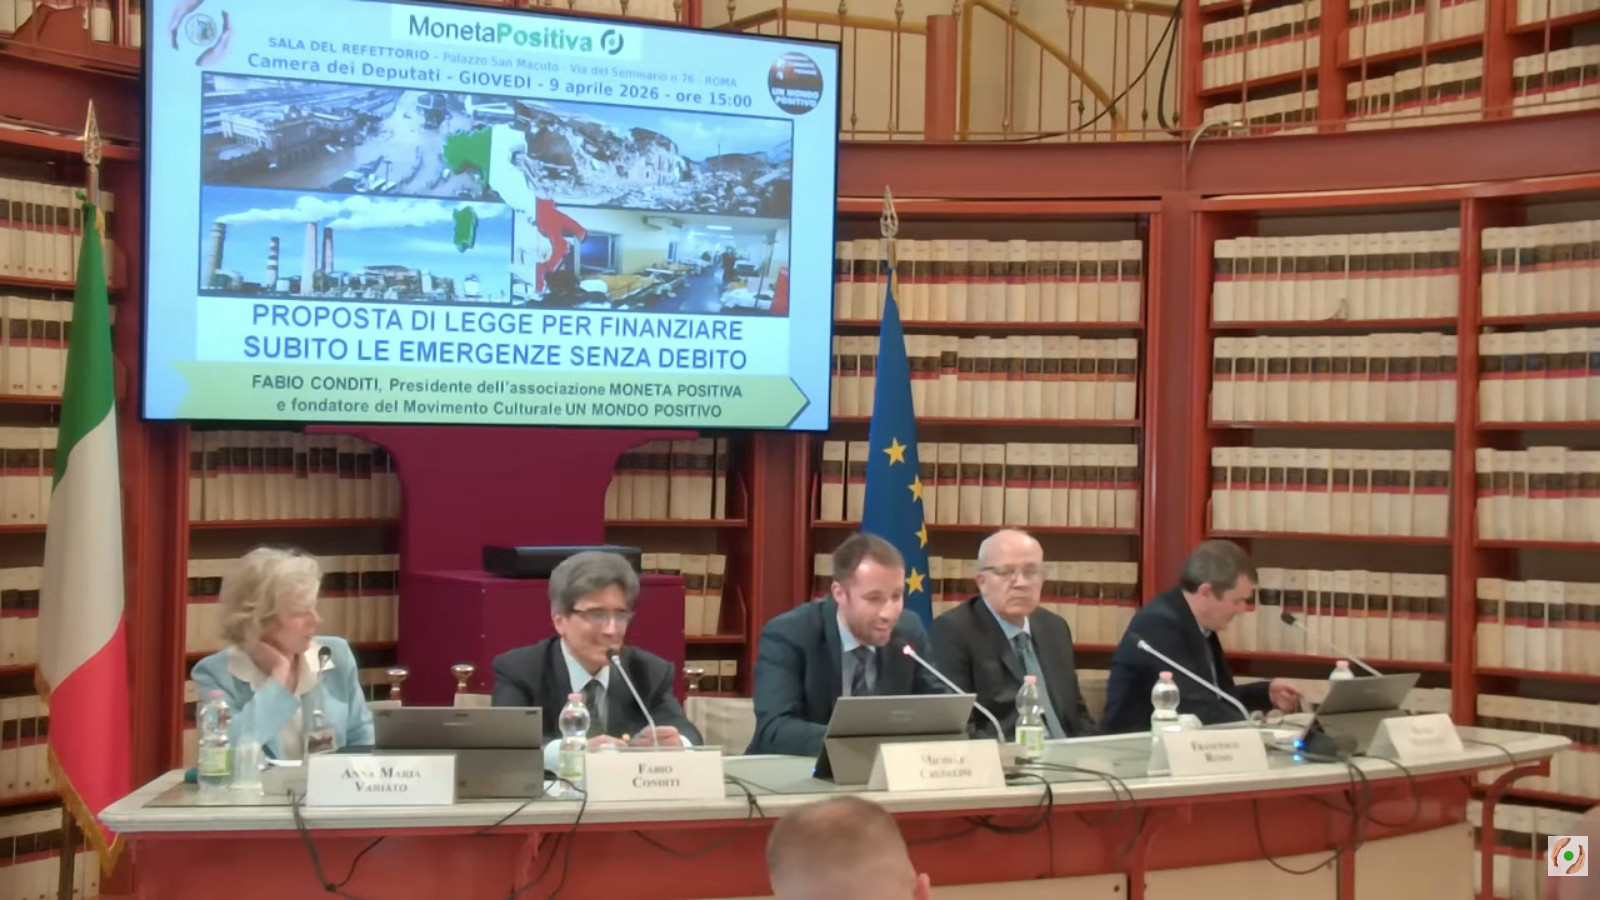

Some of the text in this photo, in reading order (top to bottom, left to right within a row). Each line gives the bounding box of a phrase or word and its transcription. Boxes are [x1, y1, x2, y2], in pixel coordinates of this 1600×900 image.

[409, 14, 593, 53] MonetaPositiva
[248, 53, 320, 73] Camera
[327, 58, 355, 75] dei
[362, 62, 441, 82] Deputati
[549, 79, 560, 92] 9
[565, 79, 613, 98] aprile
[619, 83, 660, 100] 2026
[675, 93, 703, 105] ore
[708, 92, 753, 108] 15:00
[268, 37, 305, 51] SALA
[310, 41, 336, 53] DEL
[342, 43, 430, 61] REFETTORIO
[443, 52, 487, 67] Palazzo
[491, 56, 513, 68] San
[516, 59, 559, 73] Macuto
[570, 63, 588, 74] Via
[591, 64, 609, 76] del
[612, 67, 668, 82] Seminario
[705, 76, 738, 88] ROMA
[252, 304, 744, 341] PROPOSTA DI LEGGE PER FINANZIARE
[243, 335, 748, 370] SUBITO LE EMERGENZE SENZA DEBITO
[252, 374, 743, 398] FABIO CONDITI, Presidente dell'associazione MONETA POSITIVA
[276, 398, 722, 418] e fondatore del Movimento Culturale UN MONDO POSITIVO
